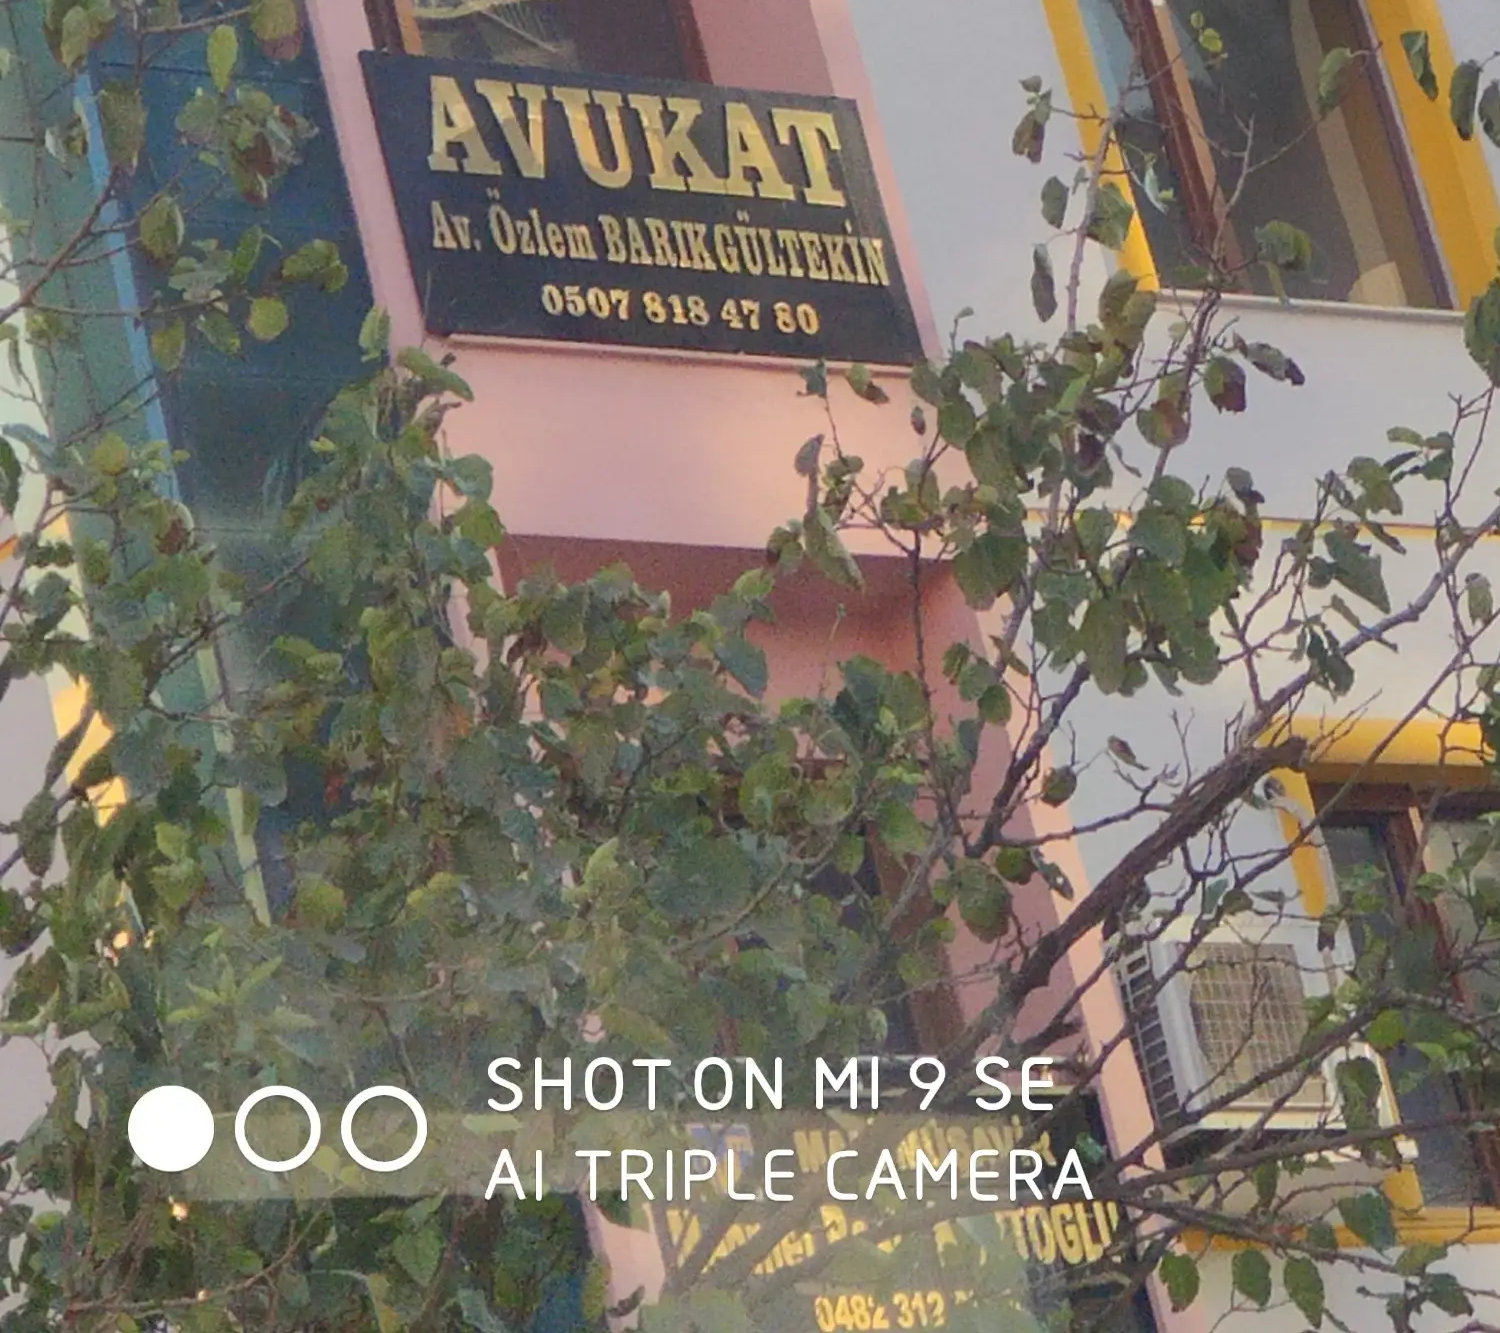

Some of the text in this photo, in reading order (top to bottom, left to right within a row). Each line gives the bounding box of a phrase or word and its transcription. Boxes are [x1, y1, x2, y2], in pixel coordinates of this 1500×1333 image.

[428, 75, 847, 208] AVUKAT
[431, 201, 482, 251] Av.
[488, 189, 597, 262] Özlem
[542, 283, 819, 336] 0507 818 47 80
